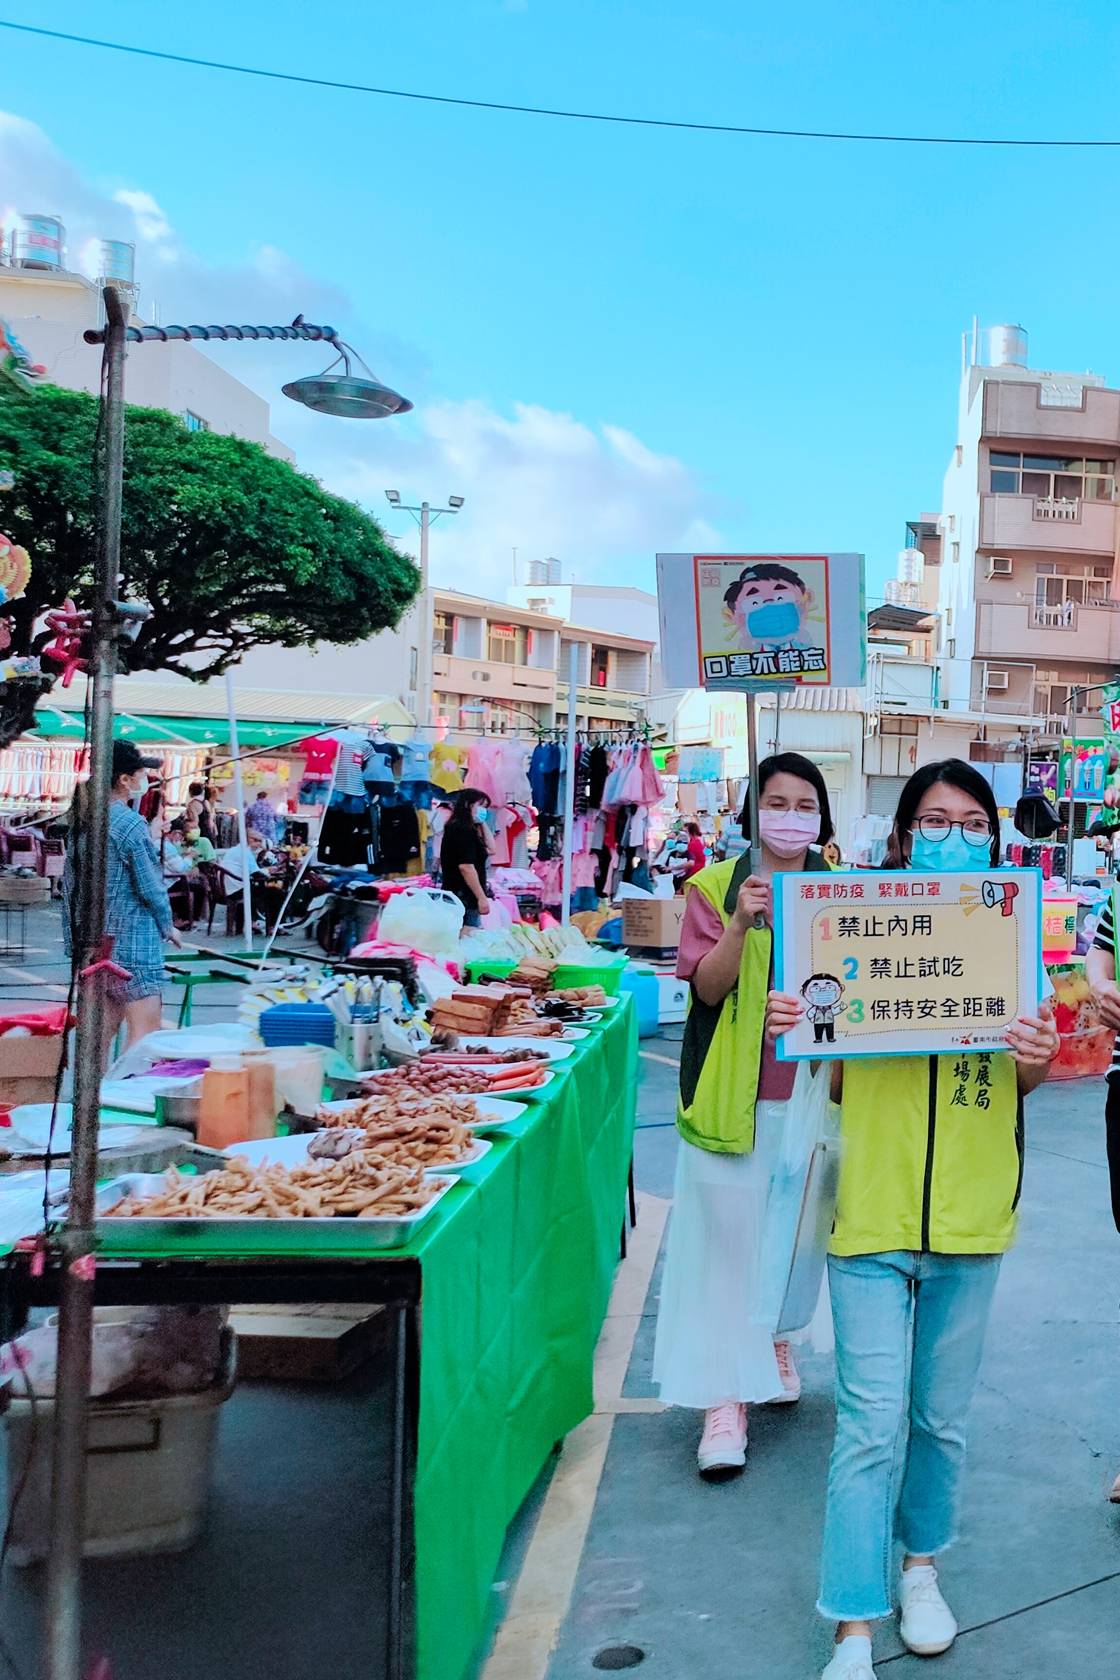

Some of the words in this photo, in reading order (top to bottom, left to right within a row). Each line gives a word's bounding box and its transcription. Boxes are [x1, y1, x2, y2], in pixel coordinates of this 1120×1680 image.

[704, 647, 827, 679] 口罩不能忘
[800, 883, 865, 899] 落實防疫
[878, 881, 941, 898] 緊戴口罩
[818, 917, 833, 941] 1
[837, 914, 932, 938] 禁止內用
[842, 956, 859, 980] 2
[869, 956, 964, 980] 禁止試吃
[846, 998, 865, 1024] 3
[870, 996, 1006, 1021] 保持安全距離
[950, 1053, 972, 1107] 場處
